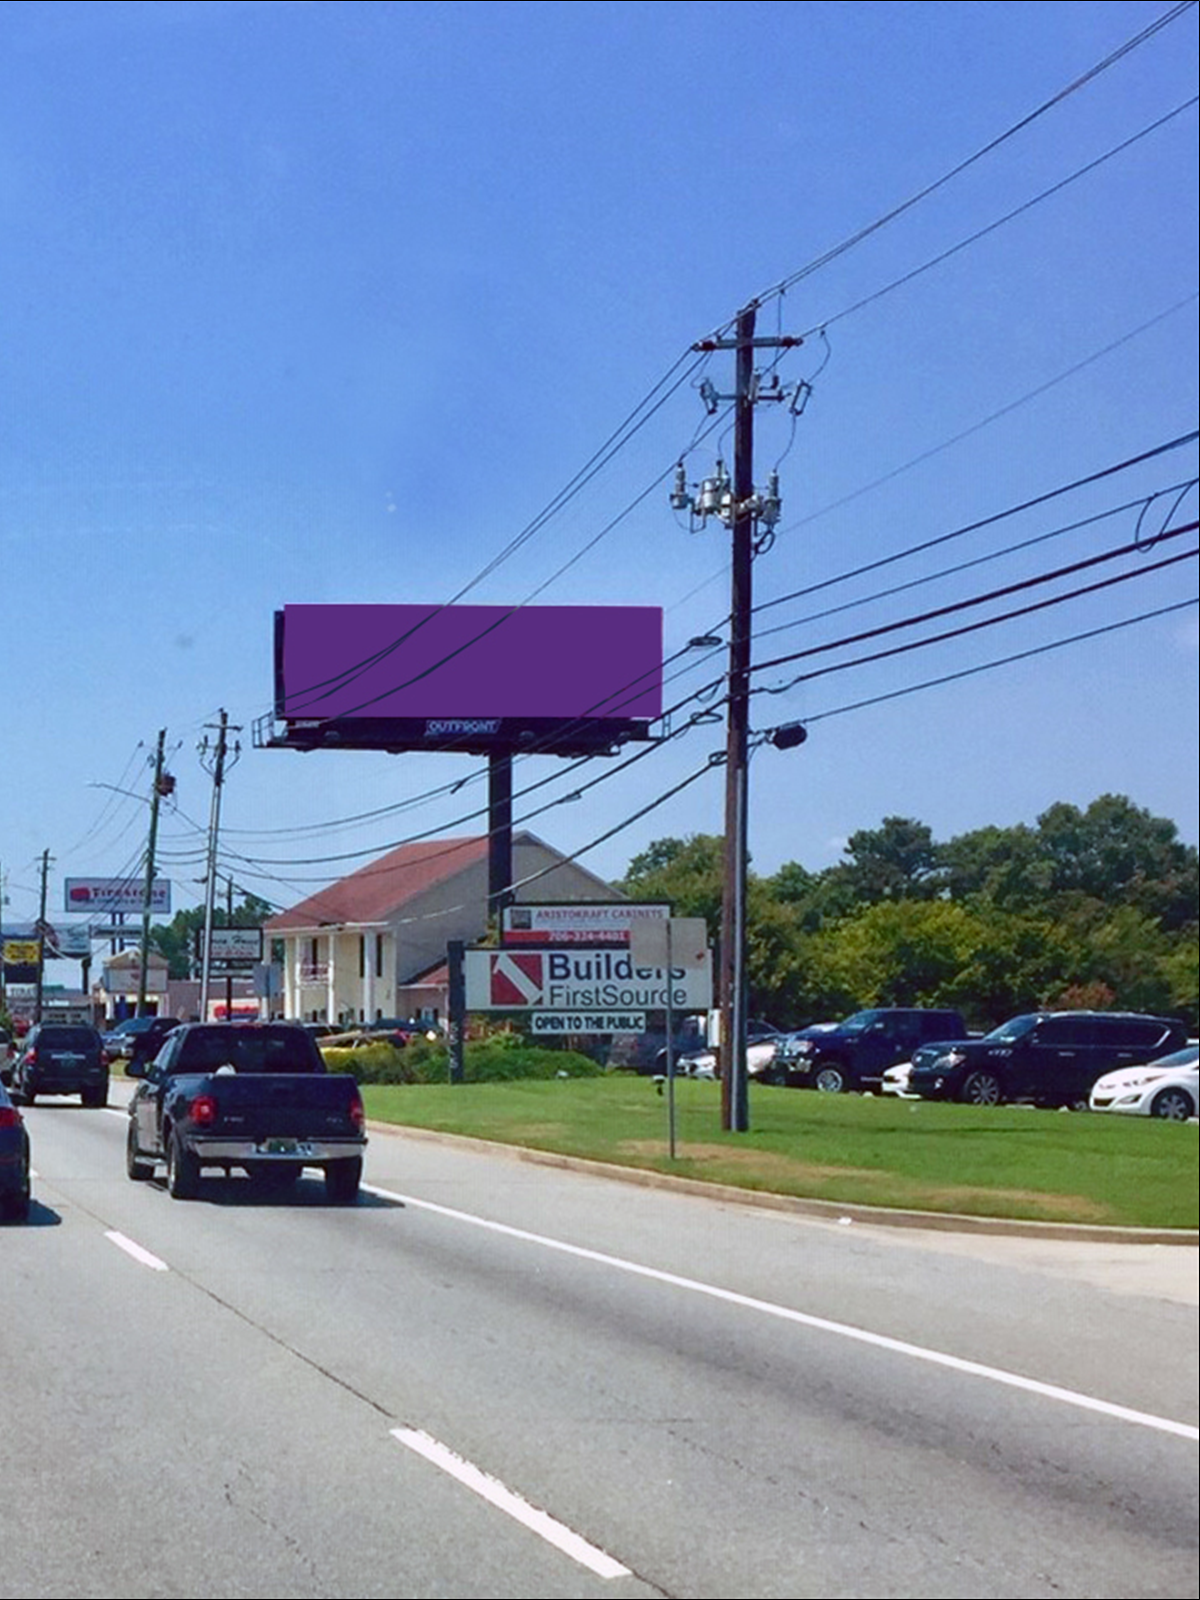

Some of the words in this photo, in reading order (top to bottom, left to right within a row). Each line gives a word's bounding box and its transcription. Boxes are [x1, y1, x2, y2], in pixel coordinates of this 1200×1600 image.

[428, 719, 496, 734] OUTFRONT
[550, 985, 687, 1006] FirstSource
[535, 1017, 564, 1030] OPEN
[567, 1017, 582, 1030] TO
[585, 1017, 604, 1030] THE
[607, 1017, 643, 1030] PUBLIC
